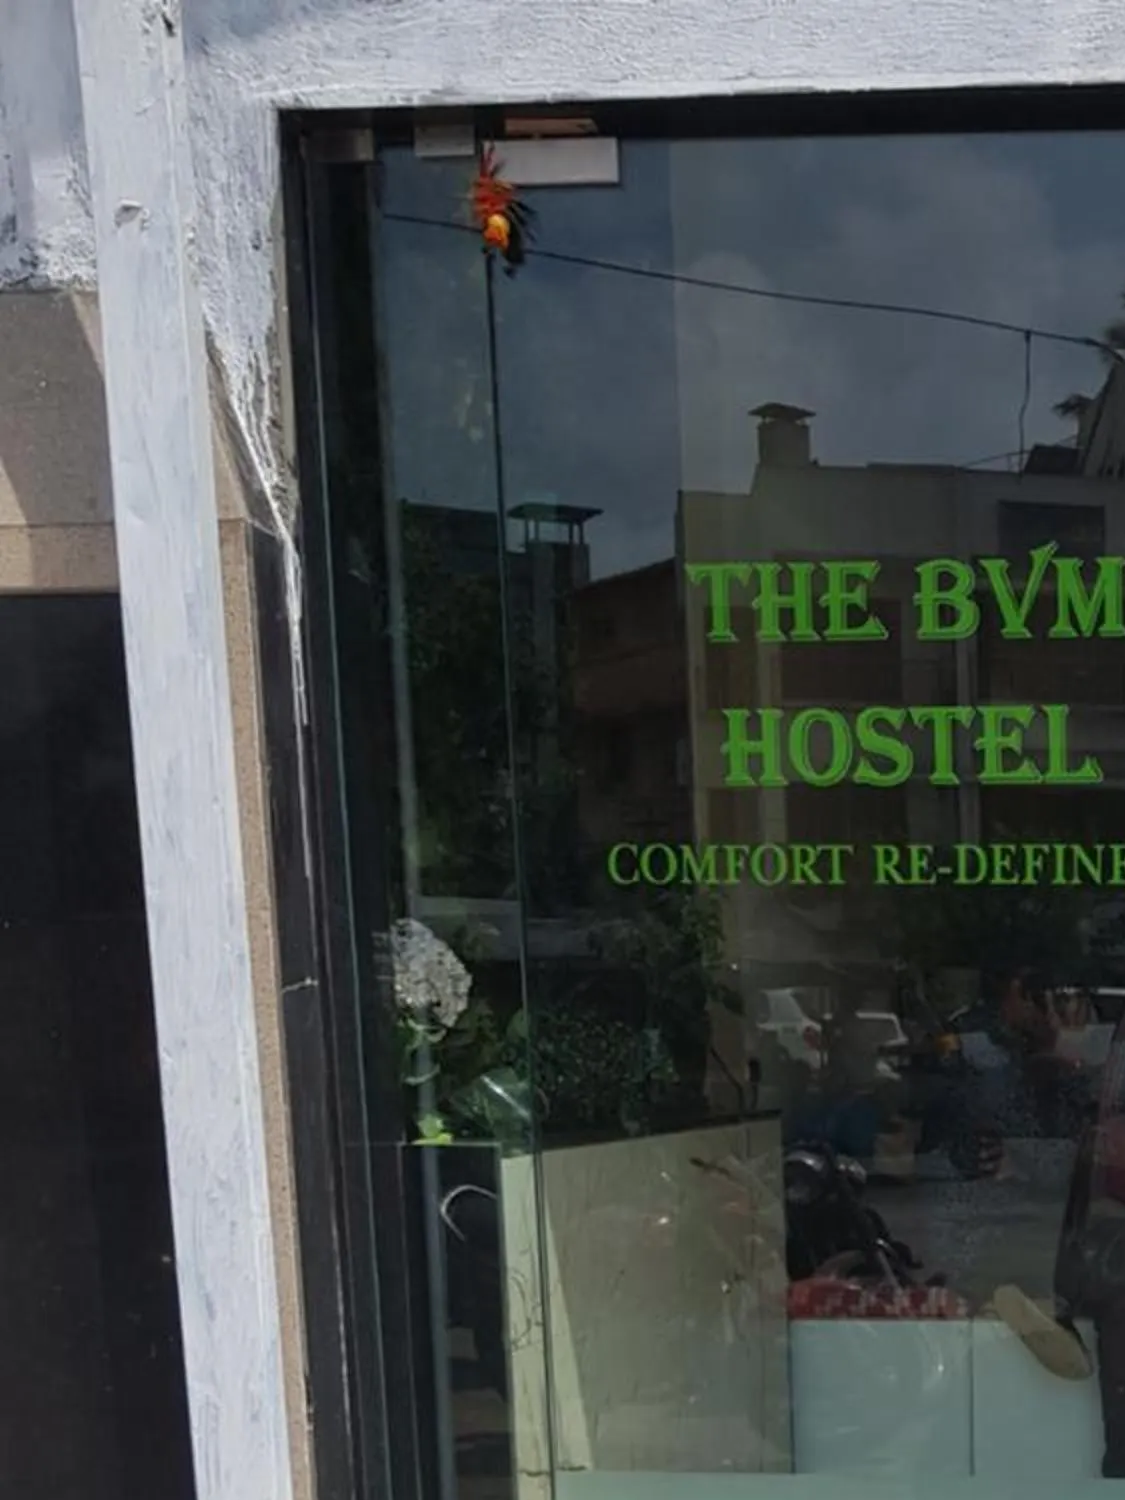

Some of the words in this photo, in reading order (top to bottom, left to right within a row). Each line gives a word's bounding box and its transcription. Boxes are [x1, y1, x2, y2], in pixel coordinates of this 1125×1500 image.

[686, 560, 889, 643] THE
[720, 703, 1104, 787] HOSTEL
[607, 843, 853, 886] COMFORT
